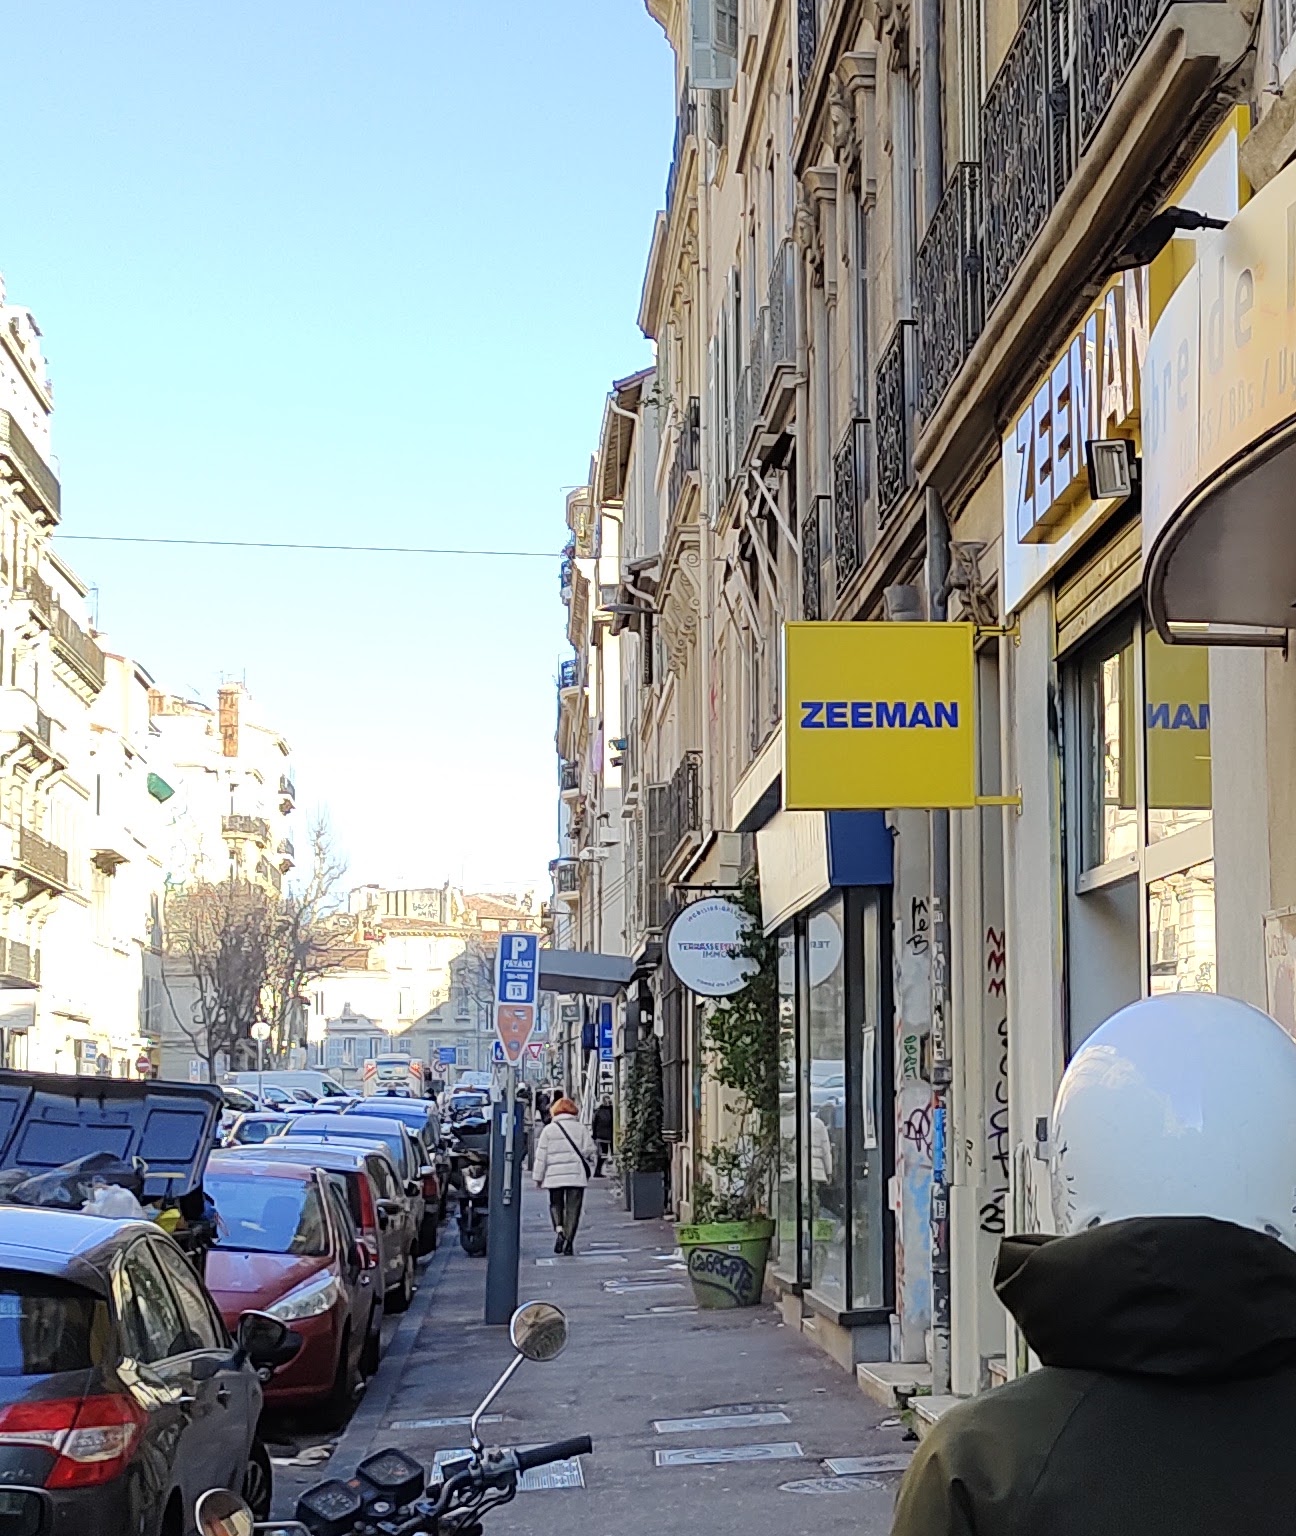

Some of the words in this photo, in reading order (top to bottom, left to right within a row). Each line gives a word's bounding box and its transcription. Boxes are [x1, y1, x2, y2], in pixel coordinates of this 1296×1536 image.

[1207, 254, 1256, 376] de
[1016, 266, 1150, 545] ZEEMAN
[800, 701, 960, 729] ZEEMAN
[511, 936, 528, 960] P
